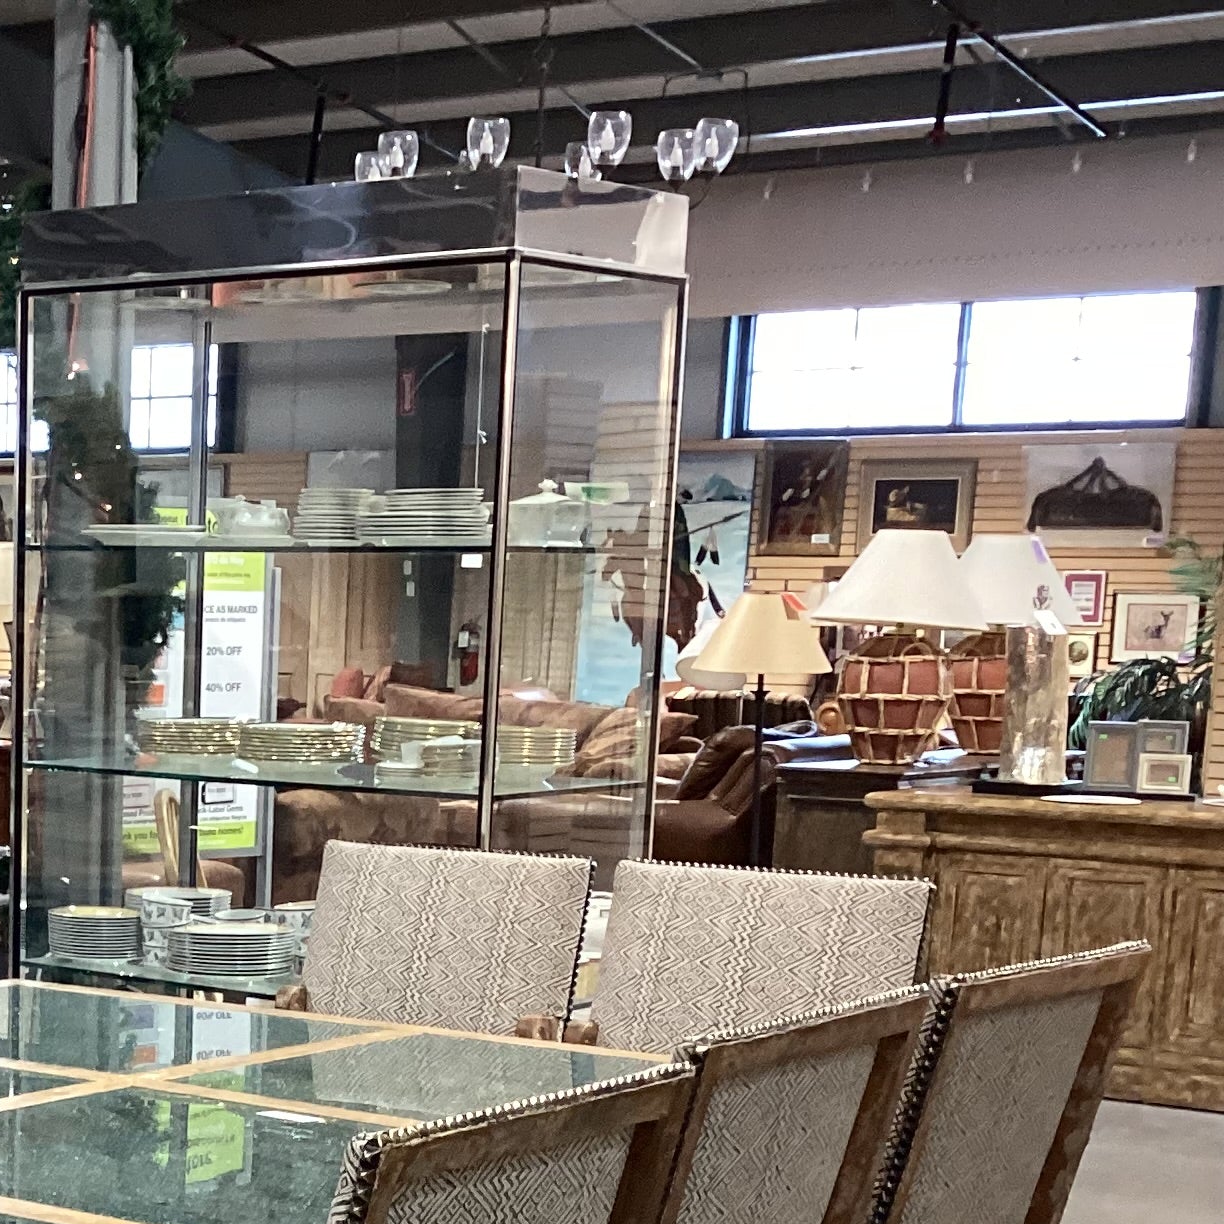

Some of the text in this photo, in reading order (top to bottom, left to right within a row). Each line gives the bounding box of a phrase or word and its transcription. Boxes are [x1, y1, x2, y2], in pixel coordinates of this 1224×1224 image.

[204, 605, 258, 614] CE AS MARKED
[206, 646, 243, 656] 20% OFF
[205, 682, 242, 692] 40% OFF
